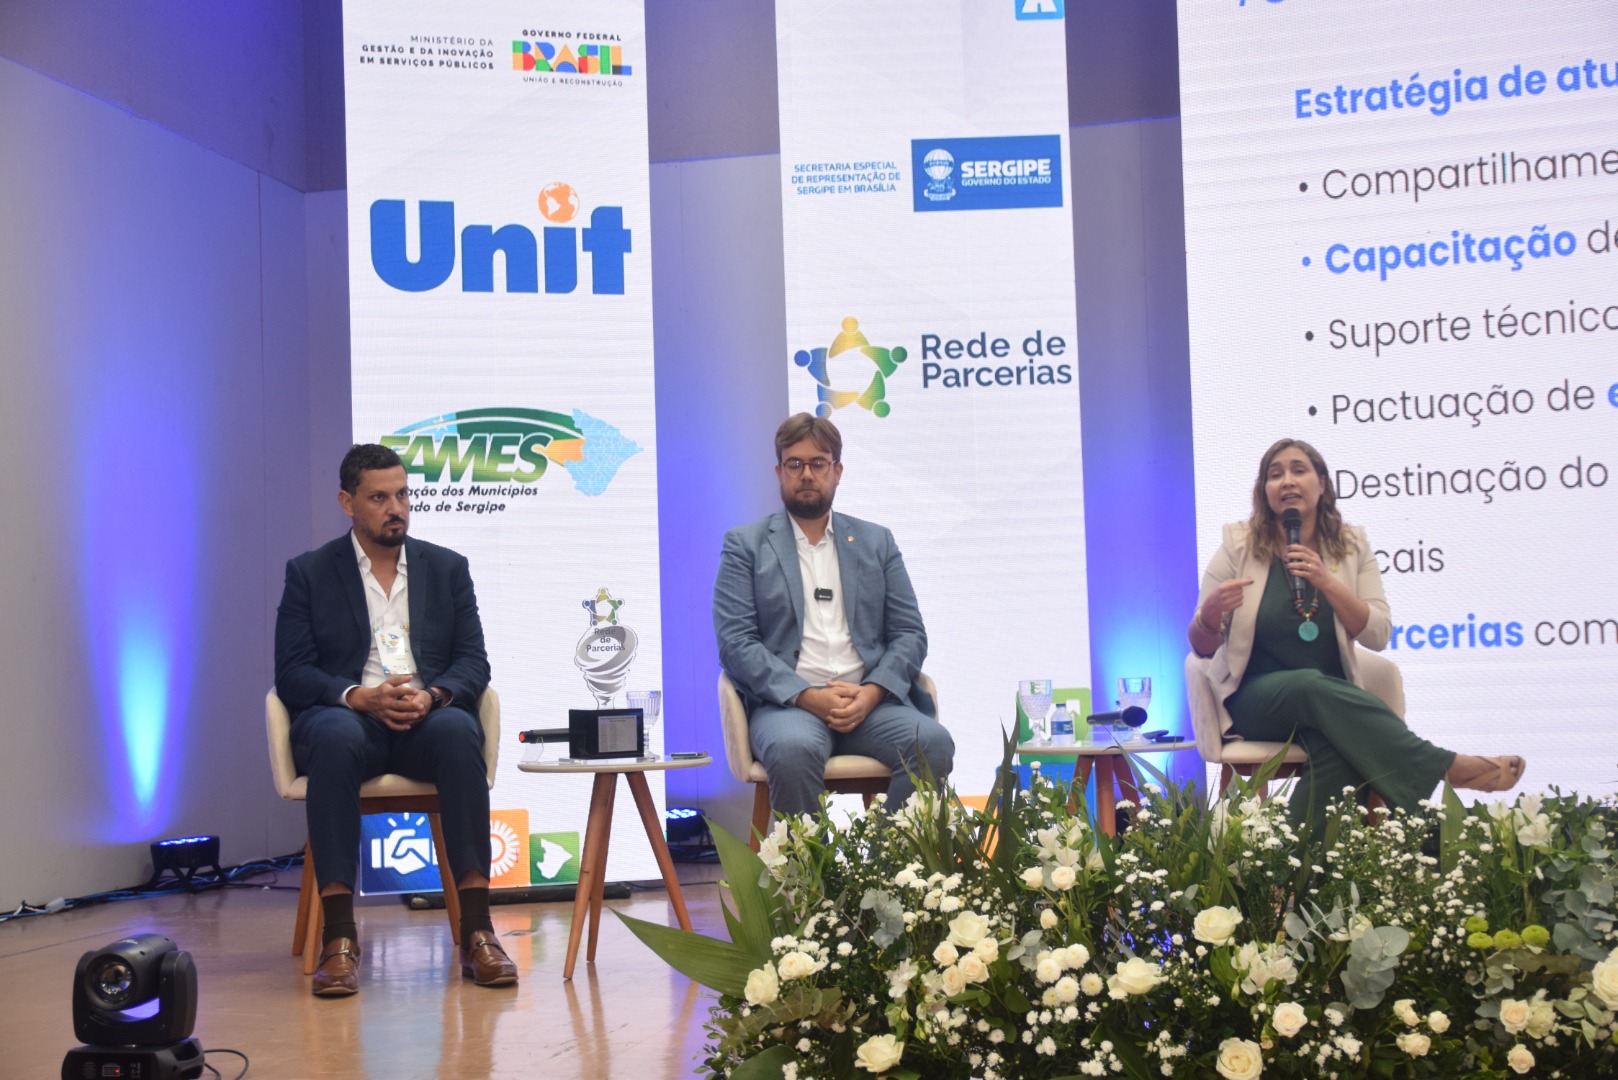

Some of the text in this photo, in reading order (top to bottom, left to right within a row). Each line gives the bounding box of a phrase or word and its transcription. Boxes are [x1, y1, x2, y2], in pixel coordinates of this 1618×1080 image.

[410, 35, 494, 46] MINISTÉRIO DA
[522, 29, 622, 42] GOVERNO FEDERAL
[362, 44, 405, 54] GESTÃO
[420, 47, 433, 55] DA
[438, 48, 494, 58] INOVAÇÃO
[512, 40, 632, 76] BRASIL
[359, 56, 494, 70] EM SERVIÇOS PÚBLICOS
[560, 78, 623, 88] RECONSTRUÇÃO
[1295, 68, 1488, 119] Estratégia
[1498, 64, 1547, 98] de
[794, 161, 897, 173] SECRETARIA ESPECIAL
[960, 158, 1052, 178] SERGIPE
[791, 172, 900, 184] DE REPRESENTAÇÃO DE
[961, 176, 1052, 187] GOVERNO DO ESTADO
[1323, 149, 1618, 203] Compartilhame
[797, 182, 896, 195] SERGIPE EM BRASÍLIA
[370, 182, 632, 295] Unit
[1325, 220, 1618, 281] Capacitação d
[1329, 299, 1618, 357] Suporte técnico
[921, 330, 1066, 360] Rede de
[922, 358, 1072, 388] Parcerias
[1332, 384, 1534, 428] Pactuação
[1547, 379, 1595, 412] de
[1334, 456, 1609, 504] Destinação do
[441, 485, 464, 496] dos
[468, 484, 538, 498] Municípios
[435, 501, 451, 512] de
[456, 501, 506, 514] Sergipe
[1386, 613, 1618, 650] rcerias com
[586, 644, 625, 652] Parcerias
